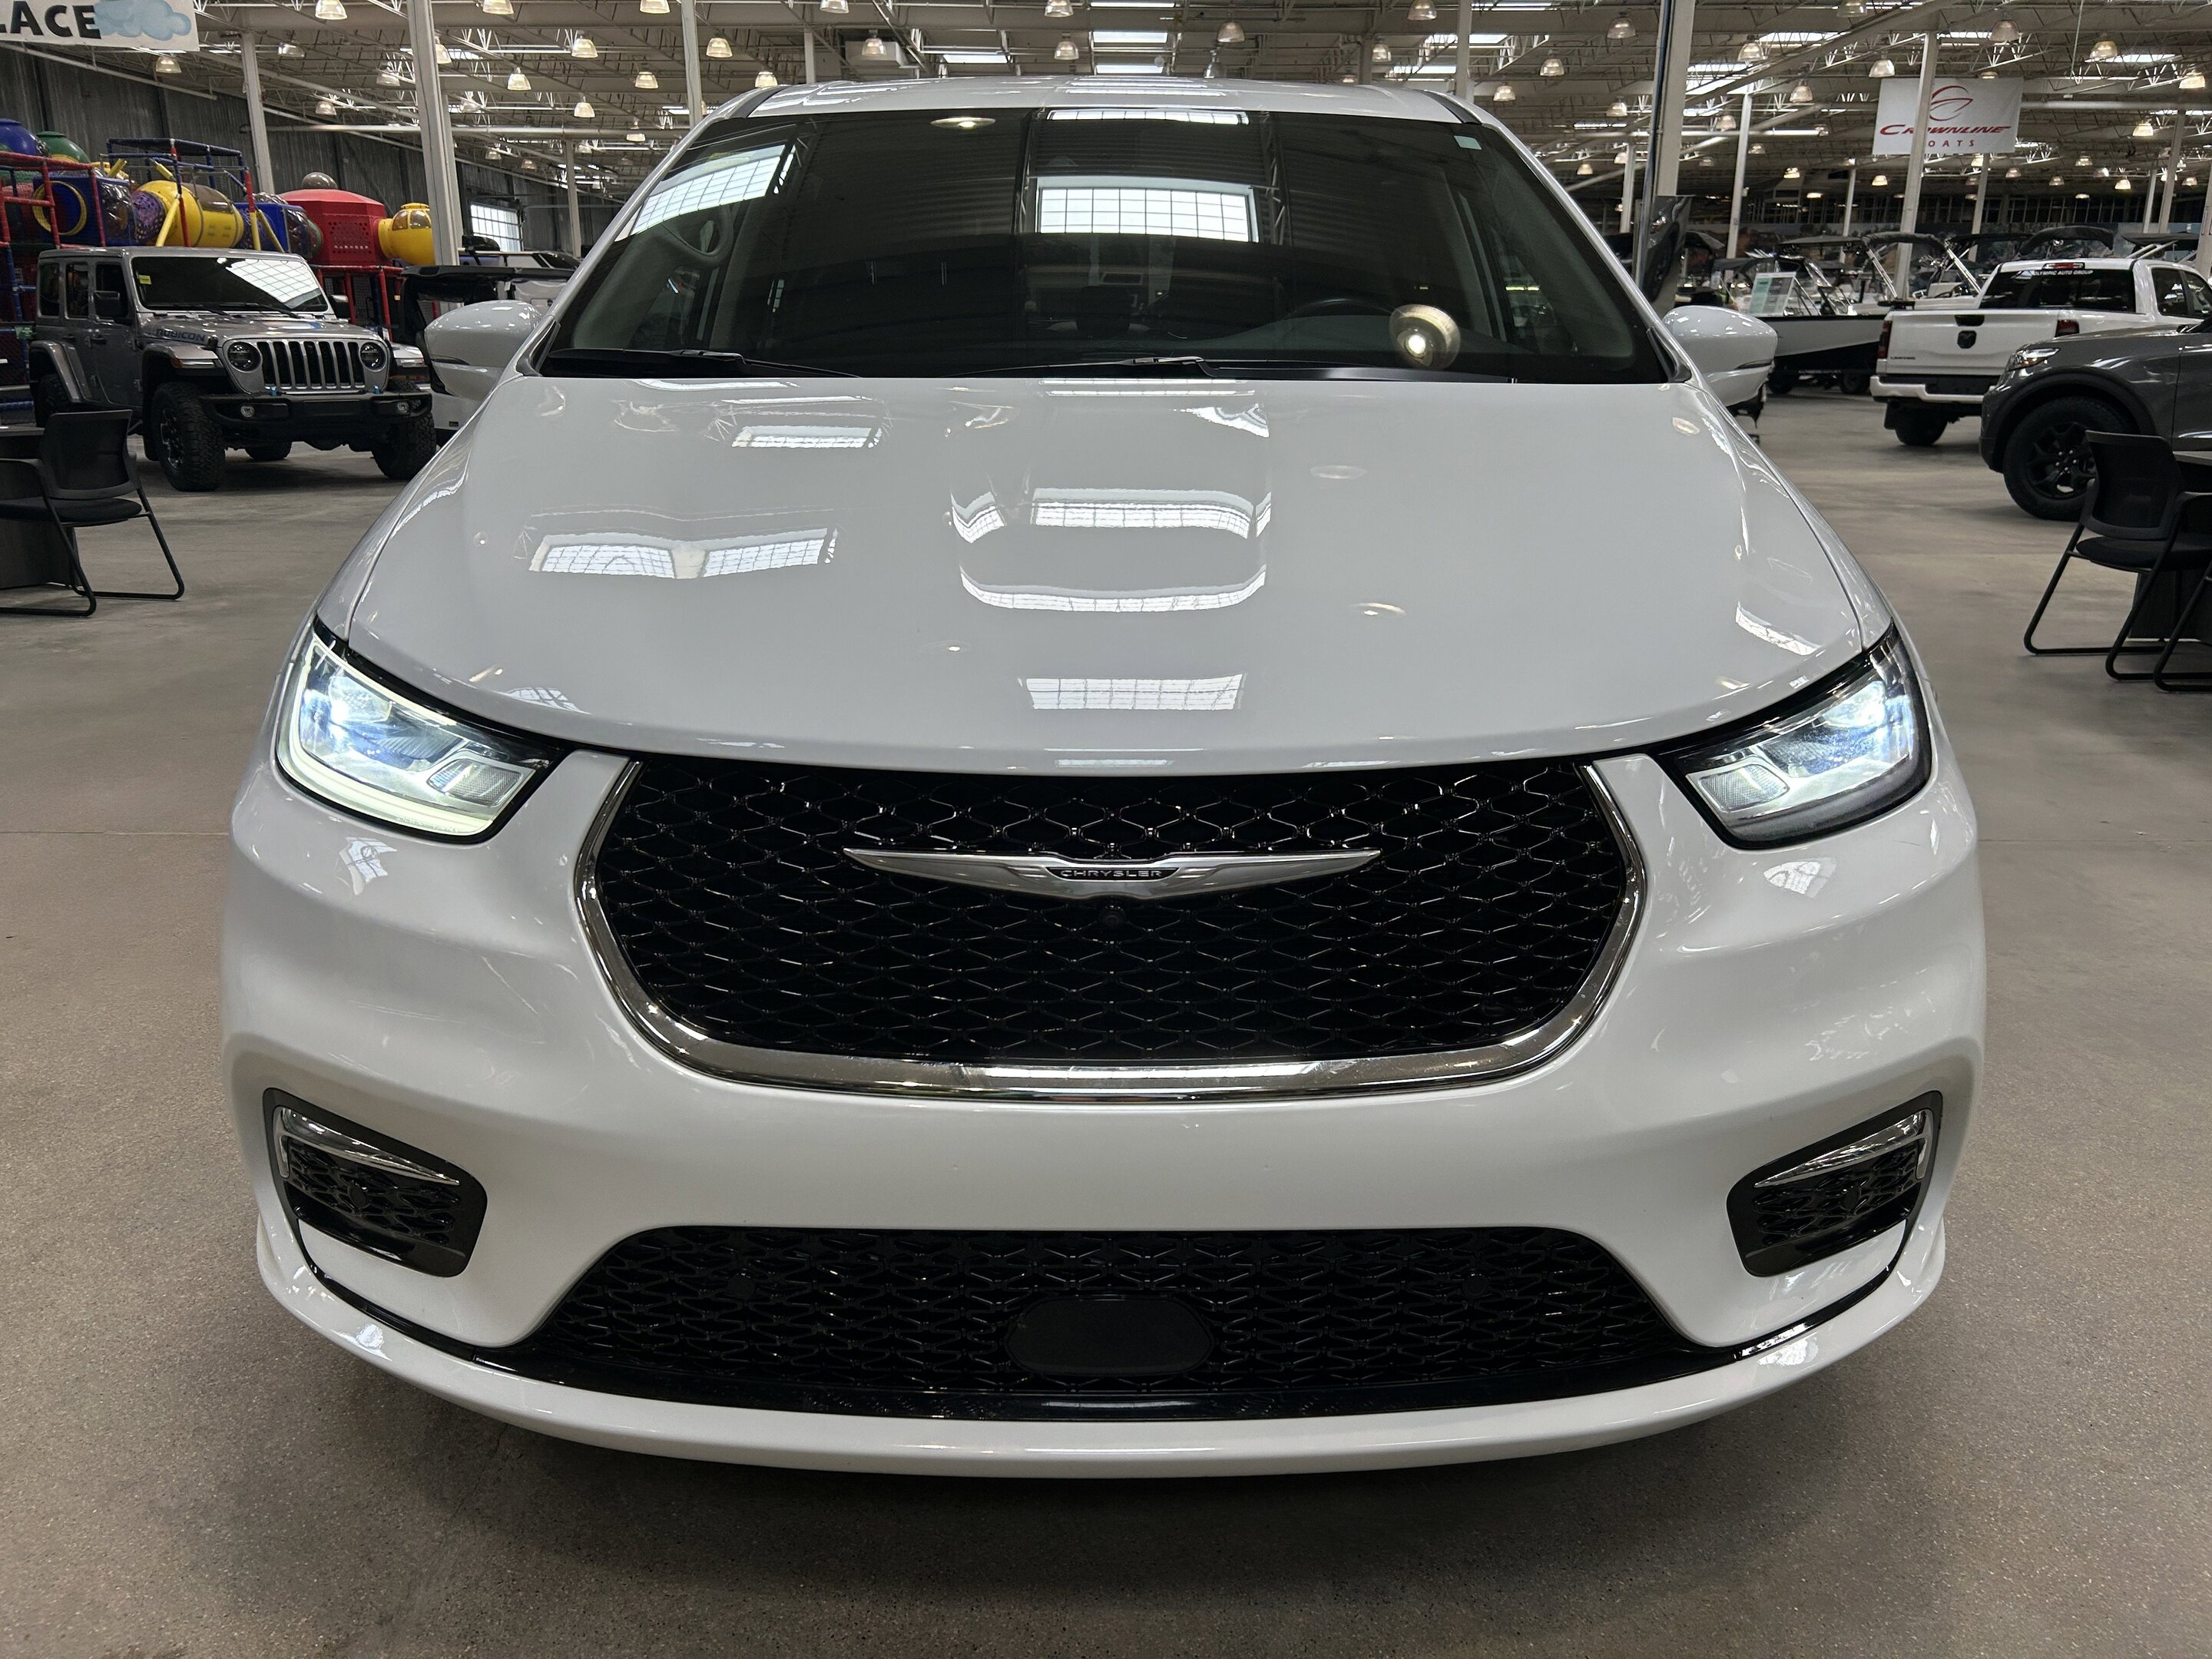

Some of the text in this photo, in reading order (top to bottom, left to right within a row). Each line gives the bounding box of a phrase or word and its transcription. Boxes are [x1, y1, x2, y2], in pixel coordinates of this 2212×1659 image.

[0, 1, 101, 39] ACE
[1880, 124, 2011, 135] CRWNLINE
[156, 328, 207, 342] RUBICON
[1060, 869, 1163, 878] CHRYSLER
